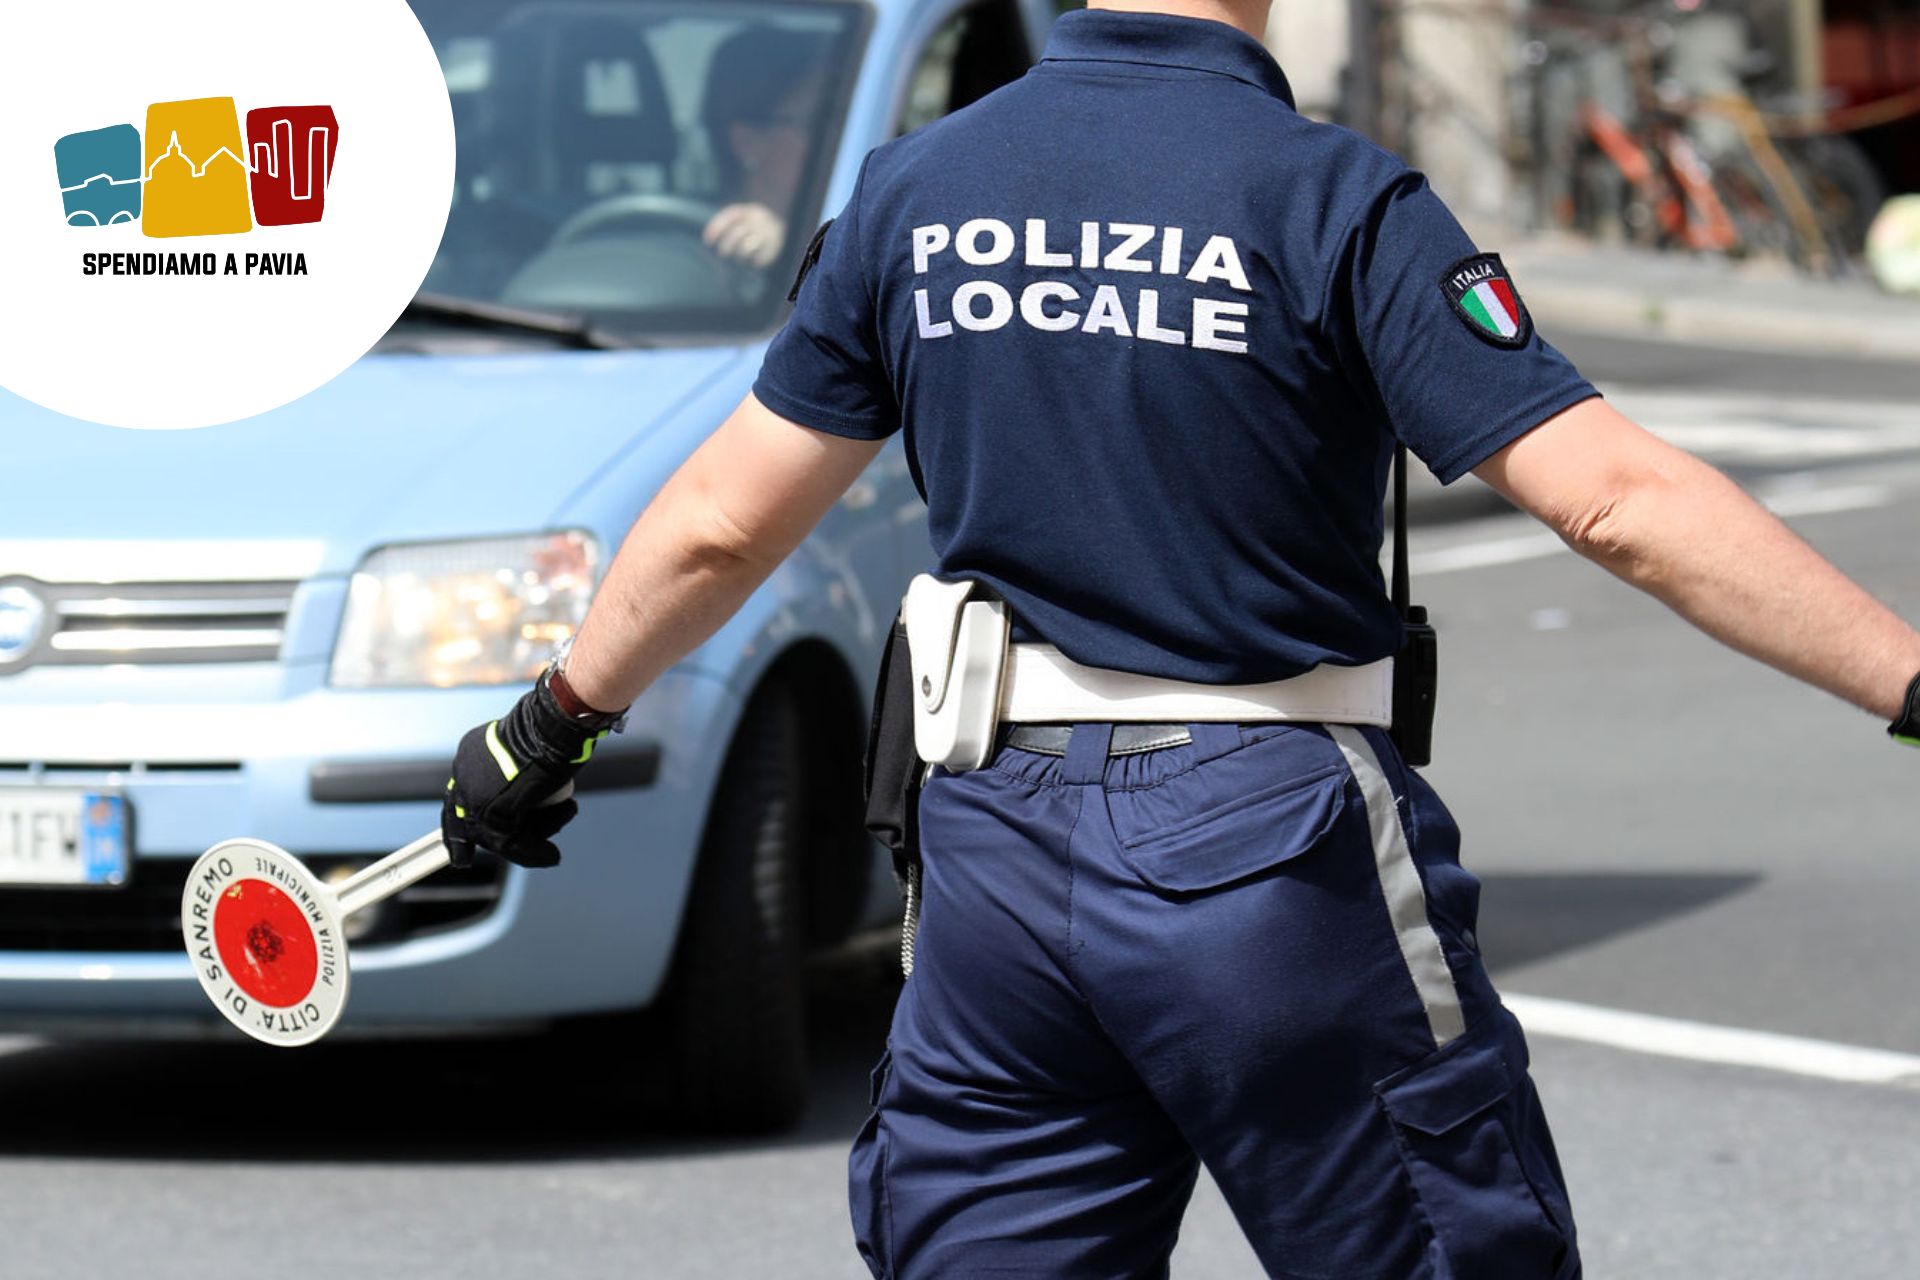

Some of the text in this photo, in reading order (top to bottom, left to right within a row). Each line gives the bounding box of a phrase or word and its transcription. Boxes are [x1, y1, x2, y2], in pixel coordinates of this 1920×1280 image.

[912, 218, 1252, 291] POLIZIA
[1452, 263, 1495, 290] ITALIA
[914, 280, 1248, 354] LOCALE
[193, 857, 233, 981] SANREMO
[255, 857, 336, 987] POLIZIA MUNICIPALE
[225, 988, 248, 1016] DI
